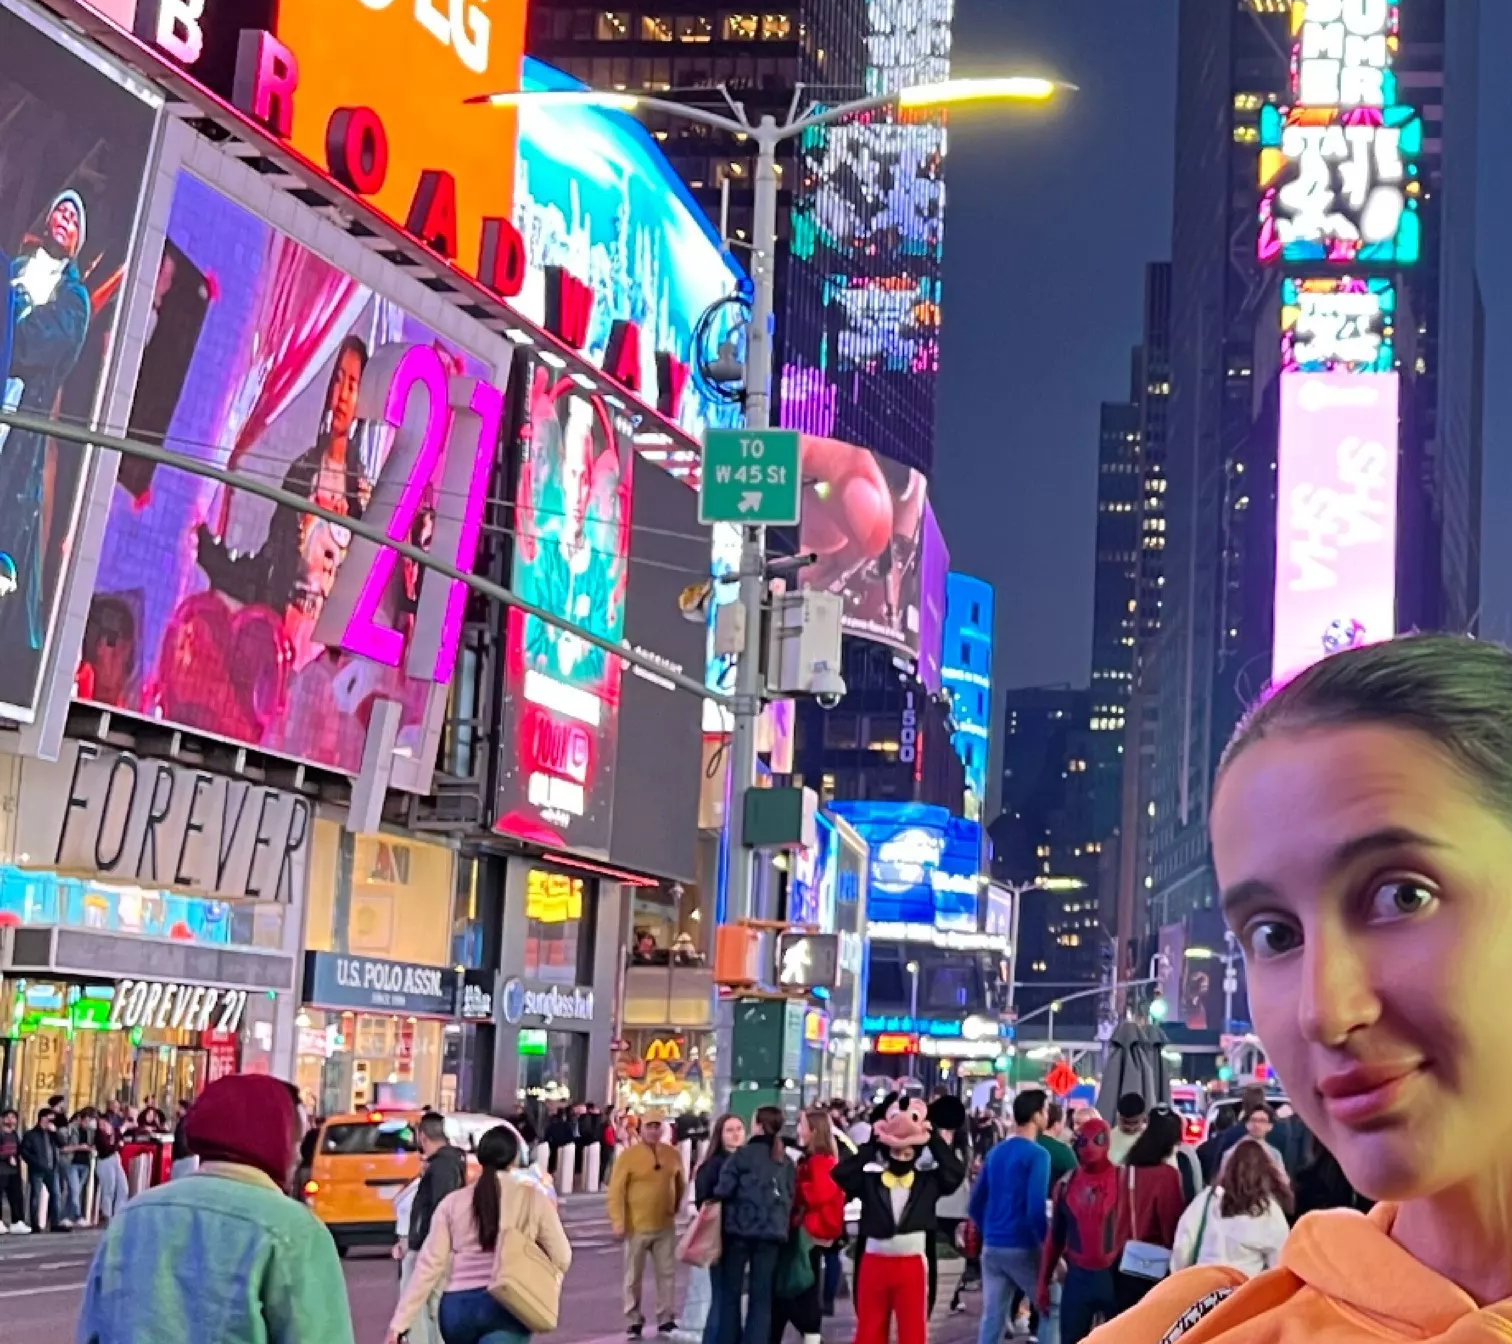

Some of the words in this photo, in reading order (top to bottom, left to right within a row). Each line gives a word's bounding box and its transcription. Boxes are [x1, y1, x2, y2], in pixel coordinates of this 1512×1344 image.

[739, 439, 764, 459] TO
[715, 464, 731, 484] W
[734, 464, 763, 484] 45
[767, 464, 786, 485] St
[335, 344, 503, 685] 21
[54, 741, 309, 904] FOREVER
[337, 958, 362, 988] U.S.
[364, 962, 403, 992] POLO
[110, 979, 217, 1032] FOREVER
[216, 989, 247, 1033] 21
